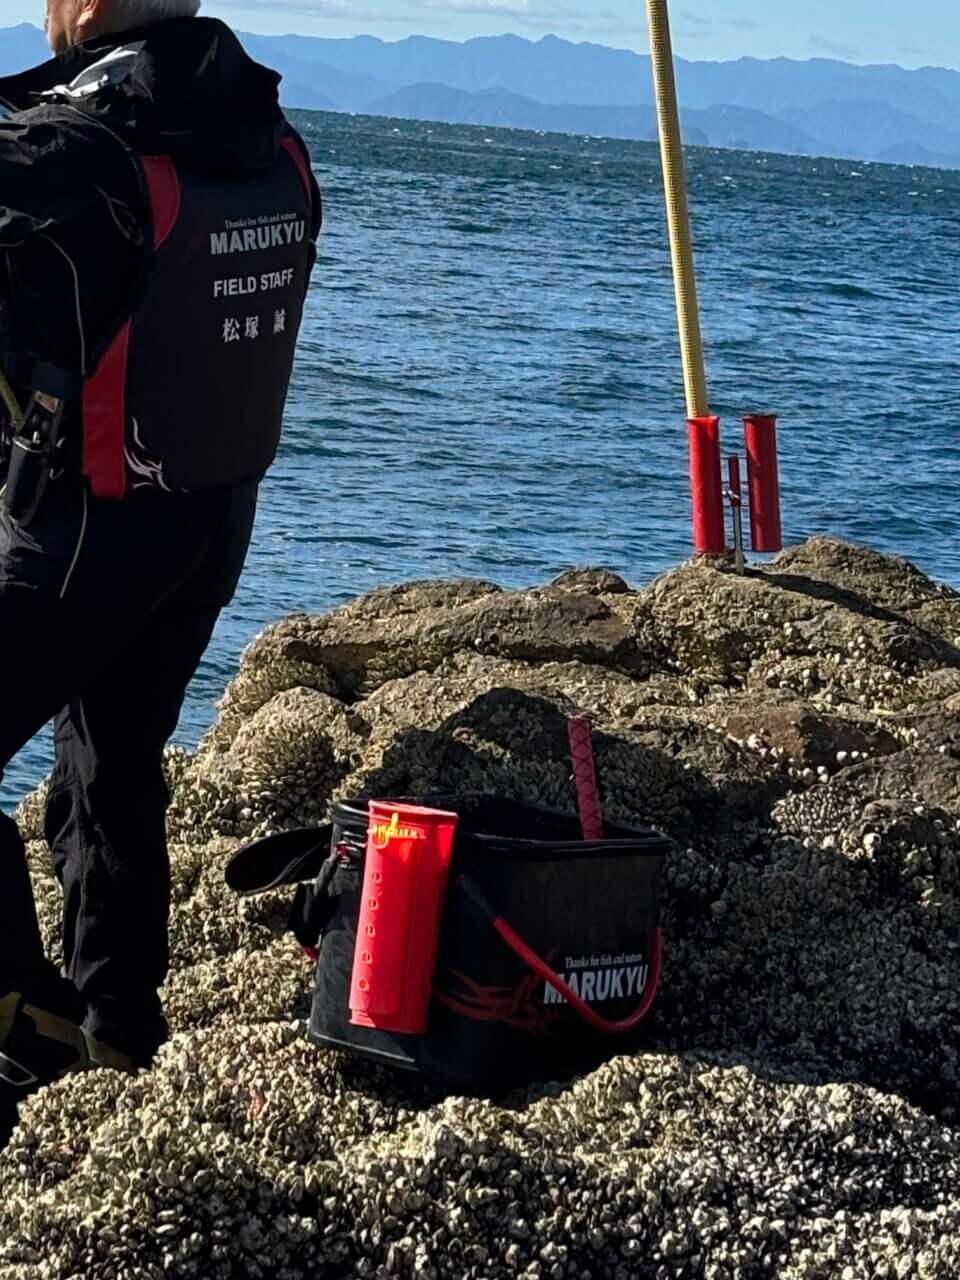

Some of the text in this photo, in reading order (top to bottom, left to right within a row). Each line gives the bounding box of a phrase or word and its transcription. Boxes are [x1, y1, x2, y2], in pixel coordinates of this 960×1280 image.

[210, 221, 304, 255] MARUKYU
[213, 268, 294, 297] FIELD STAFF
[565, 956, 589, 969] Thanks
[590, 955, 599, 967] for
[600, 953, 612, 966] fish
[613, 952, 625, 964] and
[543, 964, 648, 1004] MARUKYU
